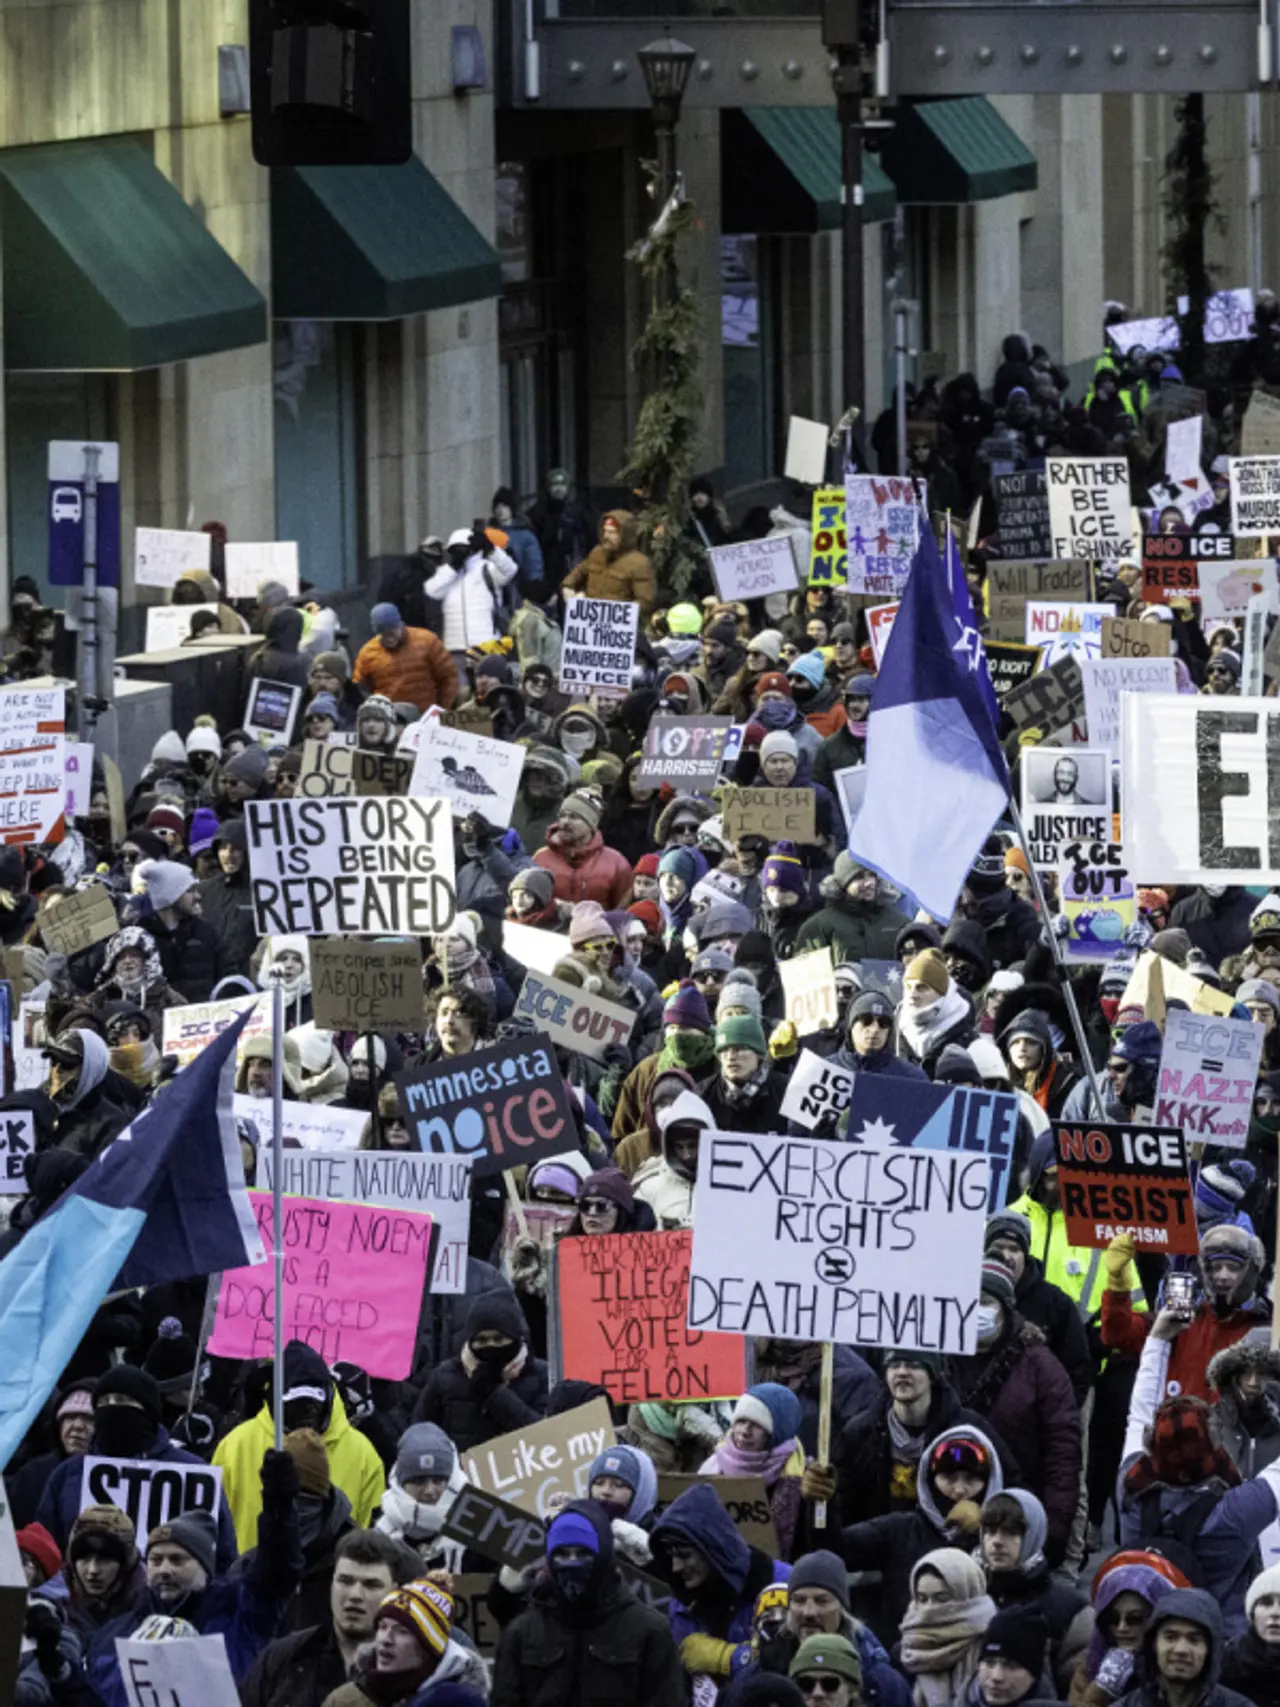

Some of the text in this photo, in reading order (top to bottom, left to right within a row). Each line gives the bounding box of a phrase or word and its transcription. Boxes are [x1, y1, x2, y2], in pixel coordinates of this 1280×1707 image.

[1049, 462, 1129, 486] RATHER
[1071, 489, 1110, 512] BE
[1069, 515, 1119, 537] ICE
[1054, 538, 1136, 560] FISHING
[1146, 537, 1232, 557] NO ICE
[1035, 562, 1084, 592] Trade
[569, 599, 632, 624] JUSTICE
[1031, 610, 1060, 633] NO
[566, 626, 634, 650] ALL THOSE
[563, 649, 632, 672] MURDERED
[562, 669, 631, 686] BY ICE
[641, 759, 698, 776] HARRIS
[728, 787, 811, 810] ABOLISH
[248, 801, 443, 847] HISTORY
[737, 814, 801, 832] ICE
[1028, 815, 1107, 844] JUSTICE
[277, 844, 437, 875] IS BEING
[1064, 842, 1124, 873] ICE
[1073, 868, 1129, 895] OUT
[252, 874, 457, 934] REPEATED
[319, 972, 404, 999] ABOLISH
[347, 998, 384, 1019] ICE
[519, 977, 631, 1045] ICE OUT
[1175, 1021, 1256, 1060] ICE
[1160, 1068, 1254, 1105] NAZI
[946, 1089, 1020, 1158] ICE
[1058, 1128, 1184, 1168] NO ICE
[709, 1138, 989, 1213] EXERCISING
[1063, 1182, 1190, 1225] RESIST
[347, 1212, 430, 1263] NOEM
[775, 1198, 916, 1251] RIGHTS
[1095, 1223, 1169, 1244] FASCISM
[591, 1265, 690, 1302] ILLEGA
[689, 1275, 979, 1352] DEATH PENALTY
[601, 1364, 711, 1401] FELON
[488, 1439, 563, 1490] Like
[567, 1426, 607, 1459] my
